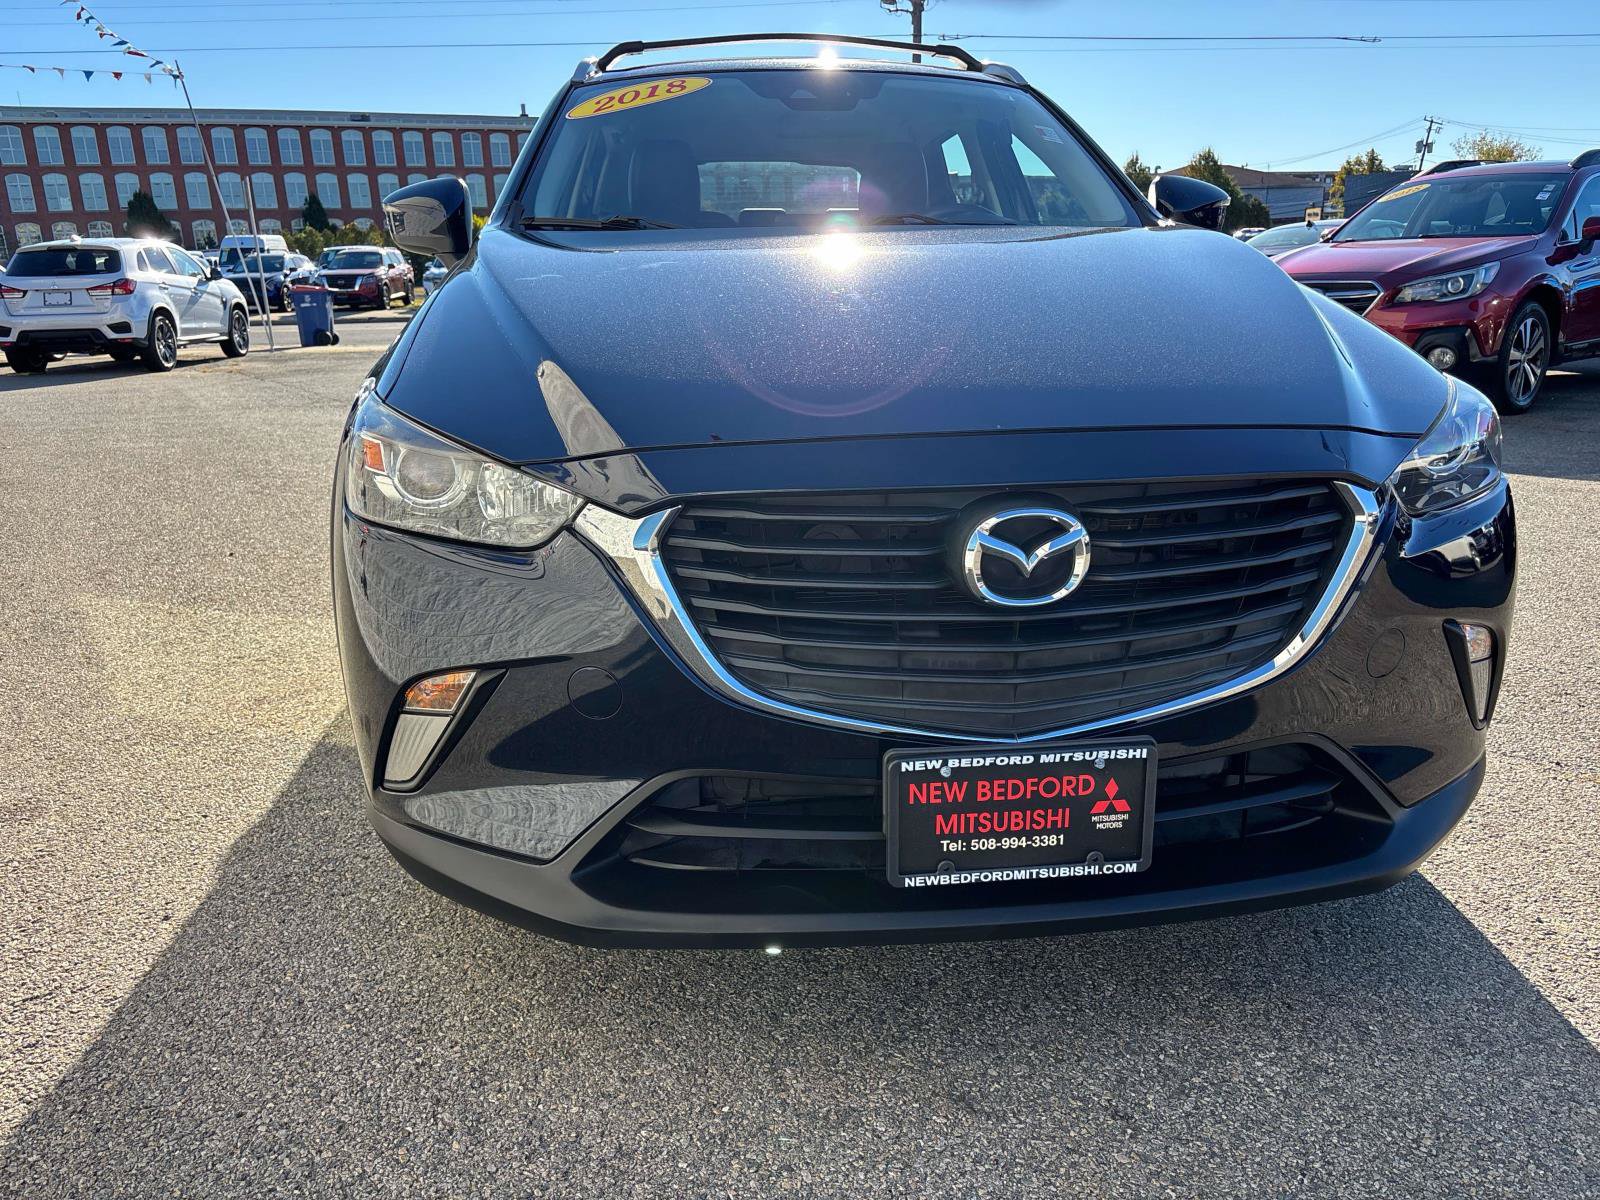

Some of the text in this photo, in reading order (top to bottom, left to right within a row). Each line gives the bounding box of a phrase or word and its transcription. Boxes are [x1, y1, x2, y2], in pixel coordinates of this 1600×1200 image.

[592, 79, 687, 113] 2018
[901, 748, 1147, 772] NEW BEDFORD MITSUBISHI
[909, 774, 1096, 804] NEW BEDFORD
[935, 807, 1070, 835] MITSUBISHI
[1091, 813, 1129, 823] MITSUBISHI
[1096, 821, 1123, 830] MOTORS
[940, 834, 1065, 852] Tel: 508-994-3381
[904, 863, 1137, 888] NEWBEDFORDMITSUBISHI.COM
